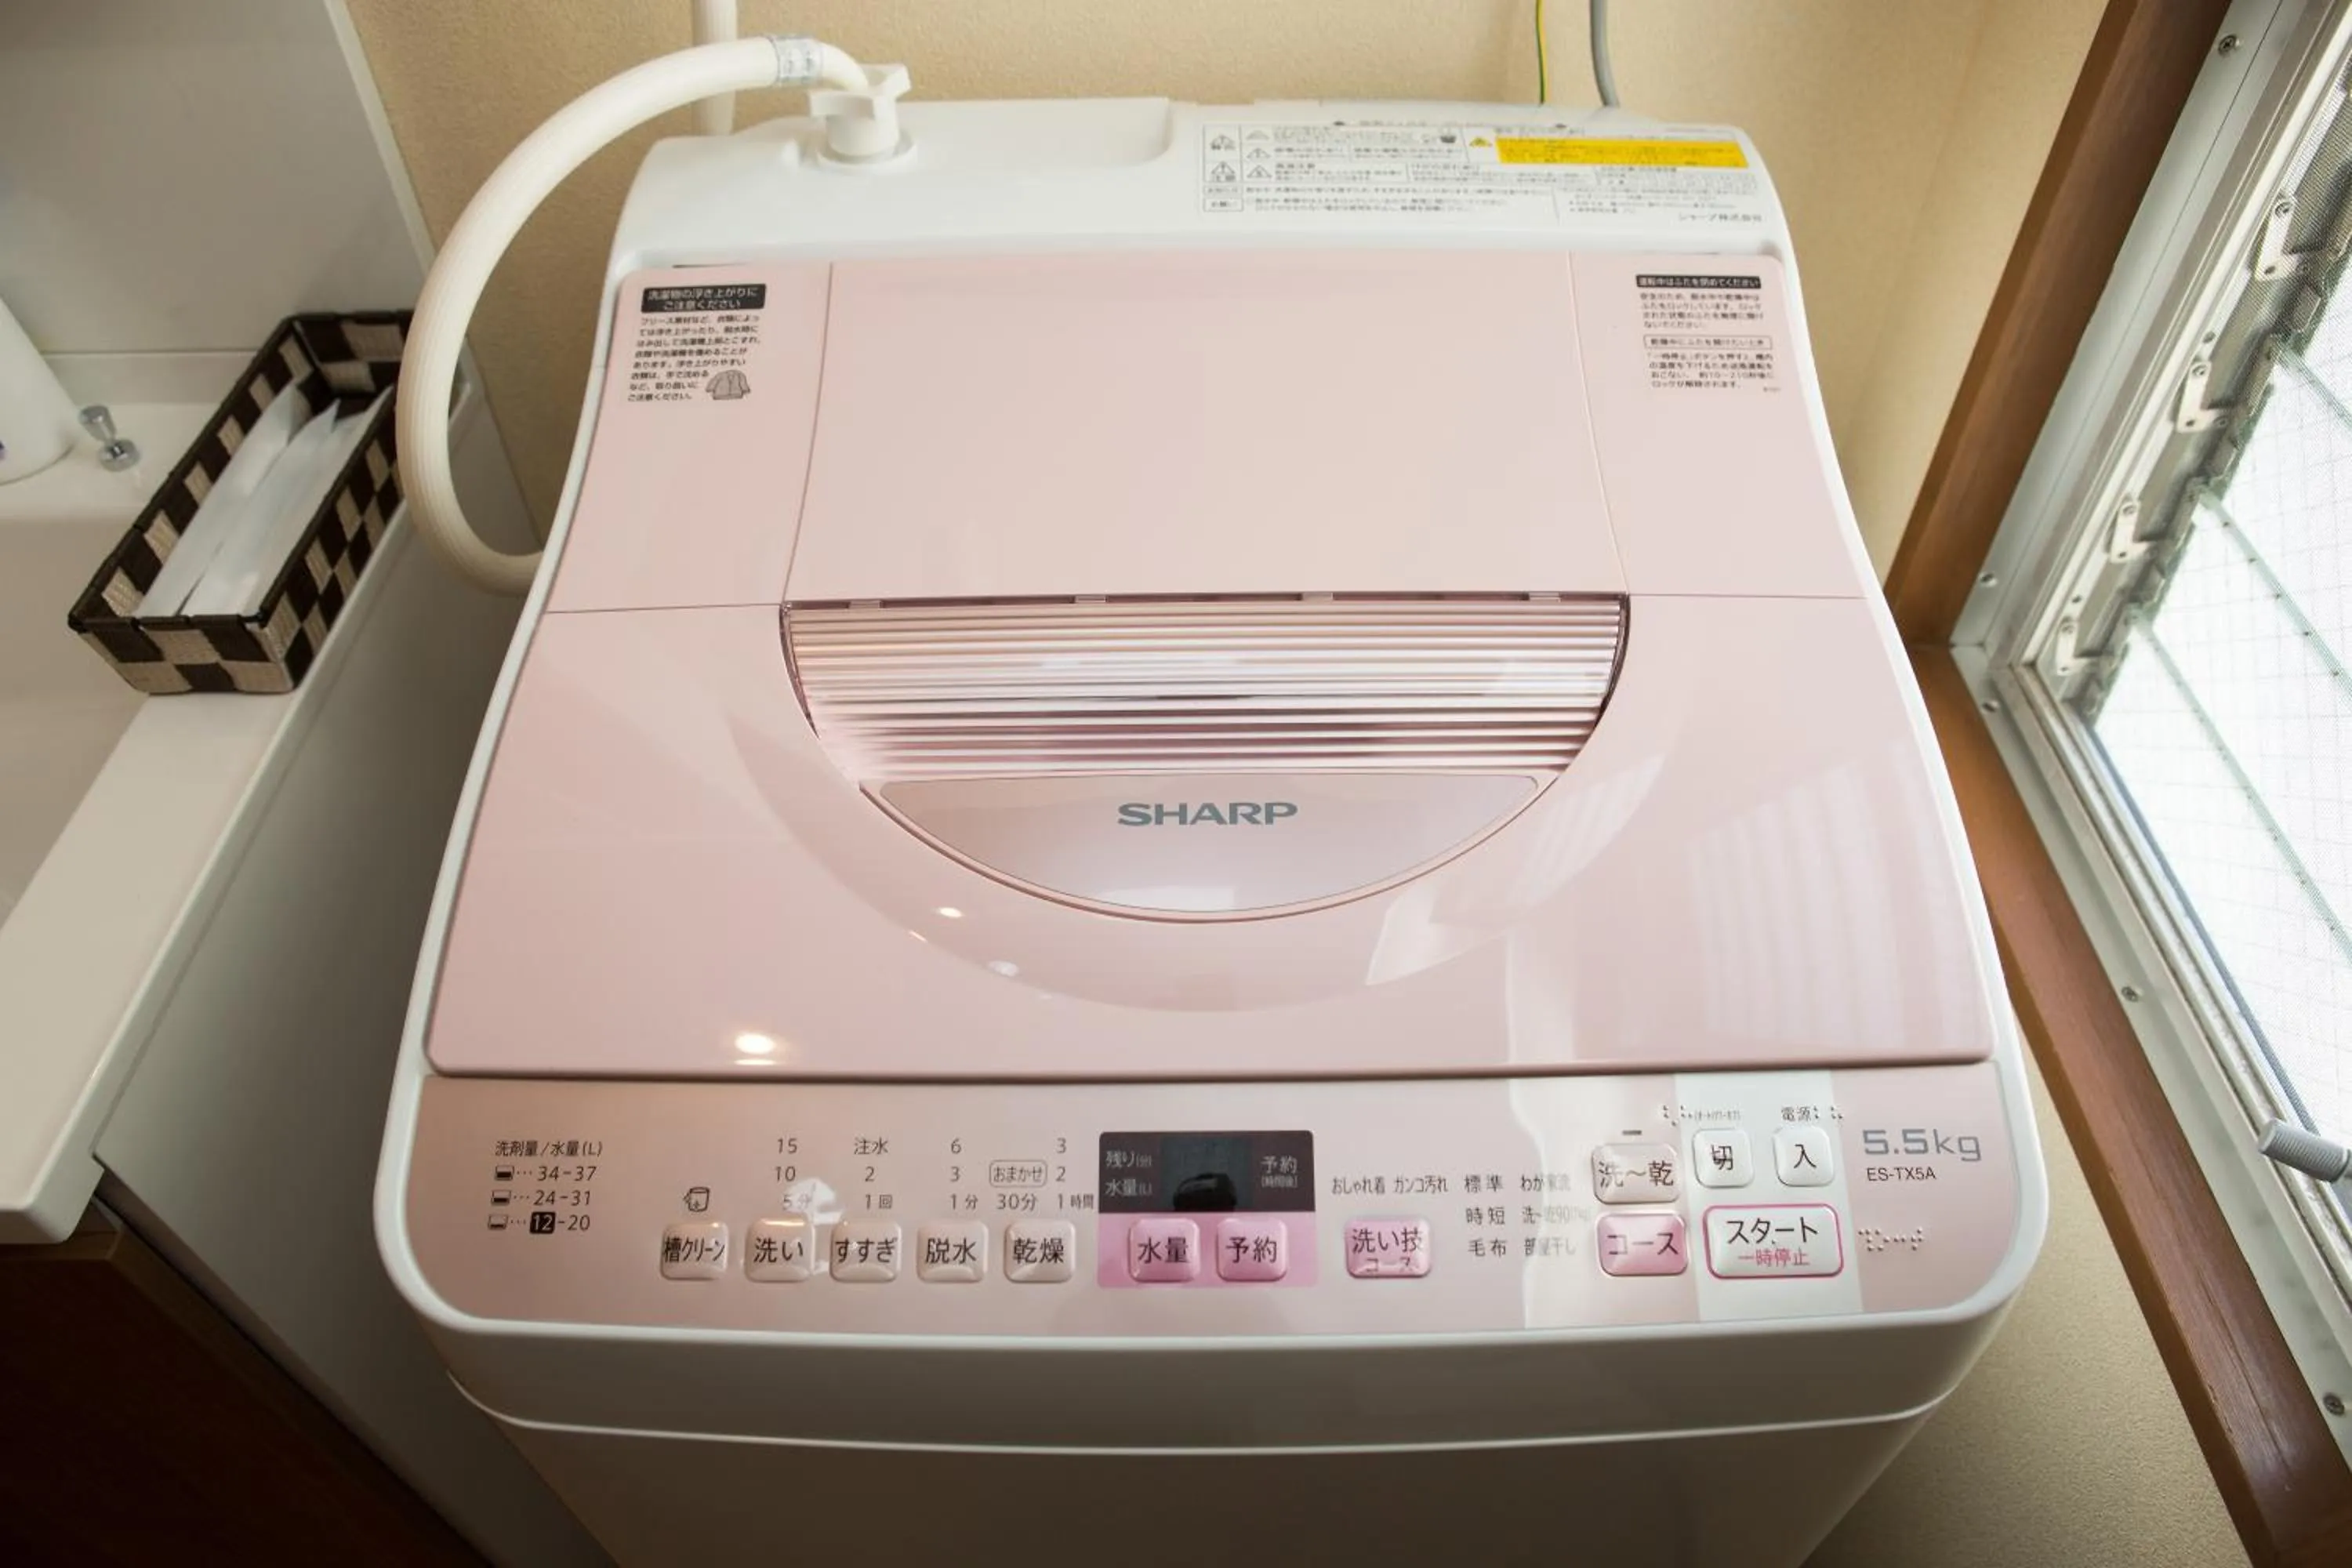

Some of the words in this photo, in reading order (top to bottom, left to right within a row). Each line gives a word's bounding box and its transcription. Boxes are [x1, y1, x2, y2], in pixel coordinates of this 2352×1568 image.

[1117, 801, 1298, 827] SHARP
[1780, 1106, 1811, 1121] 電源
[777, 1138, 798, 1153] 15
[854, 1138, 888, 1155] 注水
[950, 1138, 961, 1153] 6
[1056, 1138, 1066, 1153] 3
[1862, 1128, 1982, 1162] 5.5kg
[1261, 1154, 1298, 1174] 予約
[1711, 1145, 1733, 1171] 切
[1794, 1144, 1817, 1170] 入
[775, 1166, 796, 1181] 10
[865, 1166, 875, 1182] 2
[950, 1166, 961, 1182] 3
[993, 1165, 1044, 1183] おまかせ
[1055, 1166, 1066, 1182] 2
[1464, 1174, 1504, 1193] 標準
[1867, 1167, 1936, 1181] ES-TX5A
[1331, 1176, 1385, 1196] おしゃれ着
[1394, 1175, 1449, 1195] ガンコ汚れ
[996, 1193, 1038, 1211] 30分
[1465, 1206, 1505, 1225] 時短
[1351, 1227, 1424, 1254] 洗い技
[1726, 1216, 1818, 1245] スタート
[663, 1236, 725, 1264] 槽クリーン
[753, 1237, 804, 1265] 洗い
[834, 1237, 898, 1264] すすぎ
[924, 1237, 977, 1265] 脱水
[1012, 1236, 1065, 1265] 乾燥
[1137, 1236, 1192, 1264] 水量
[1225, 1236, 1278, 1265] 予約
[1468, 1238, 1508, 1258] 毛布
[1606, 1231, 1679, 1255] コース
[1738, 1248, 1810, 1268] 一時停止
